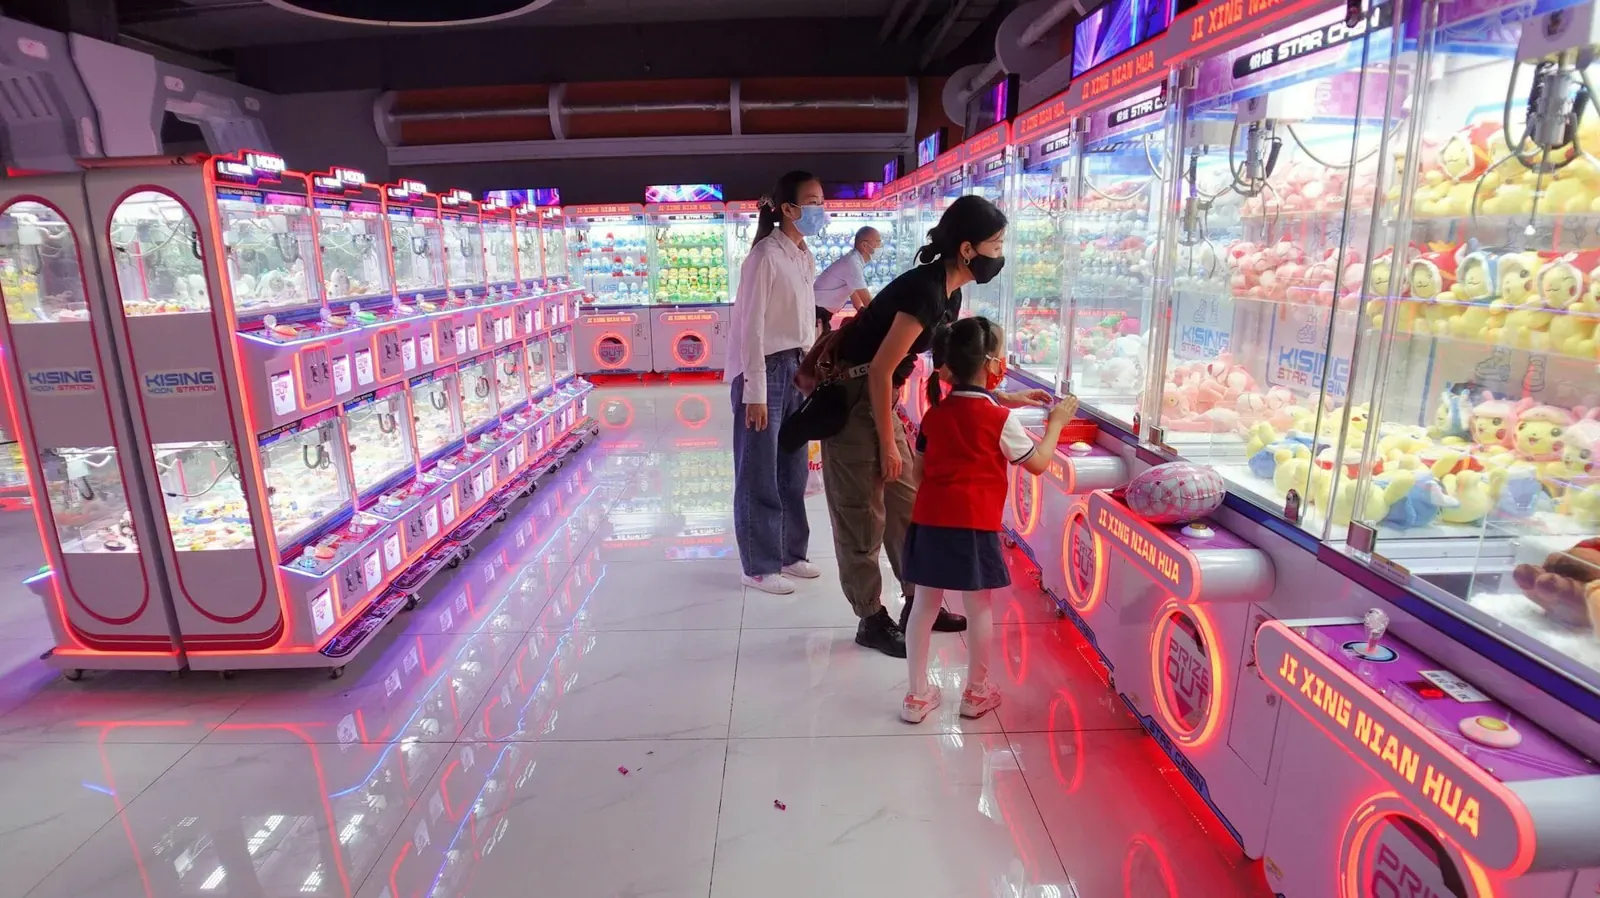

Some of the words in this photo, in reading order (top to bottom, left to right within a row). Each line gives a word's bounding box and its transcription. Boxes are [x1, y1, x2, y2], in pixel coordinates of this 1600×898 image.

[1191, 15, 1204, 42] JI
[1208, 1, 1243, 34] XING
[1277, 30, 1323, 60] STAR
[1181, 325, 1229, 348] KISING
[28, 370, 94, 385] KISING
[145, 371, 215, 387] KISING
[1277, 367, 1308, 386] STAR
[1098, 507, 1107, 528] JI
[1108, 512, 1130, 545] XING
[1131, 530, 1157, 566] NIAN
[1158, 550, 1179, 585] HUA
[1169, 637, 1209, 689] PRIZE
[1167, 655, 1208, 709] OUT
[1279, 653, 1298, 686] JI
[1300, 666, 1352, 729] XING
[1354, 710, 1420, 784] NIAN
[1422, 764, 1481, 839] HUA
